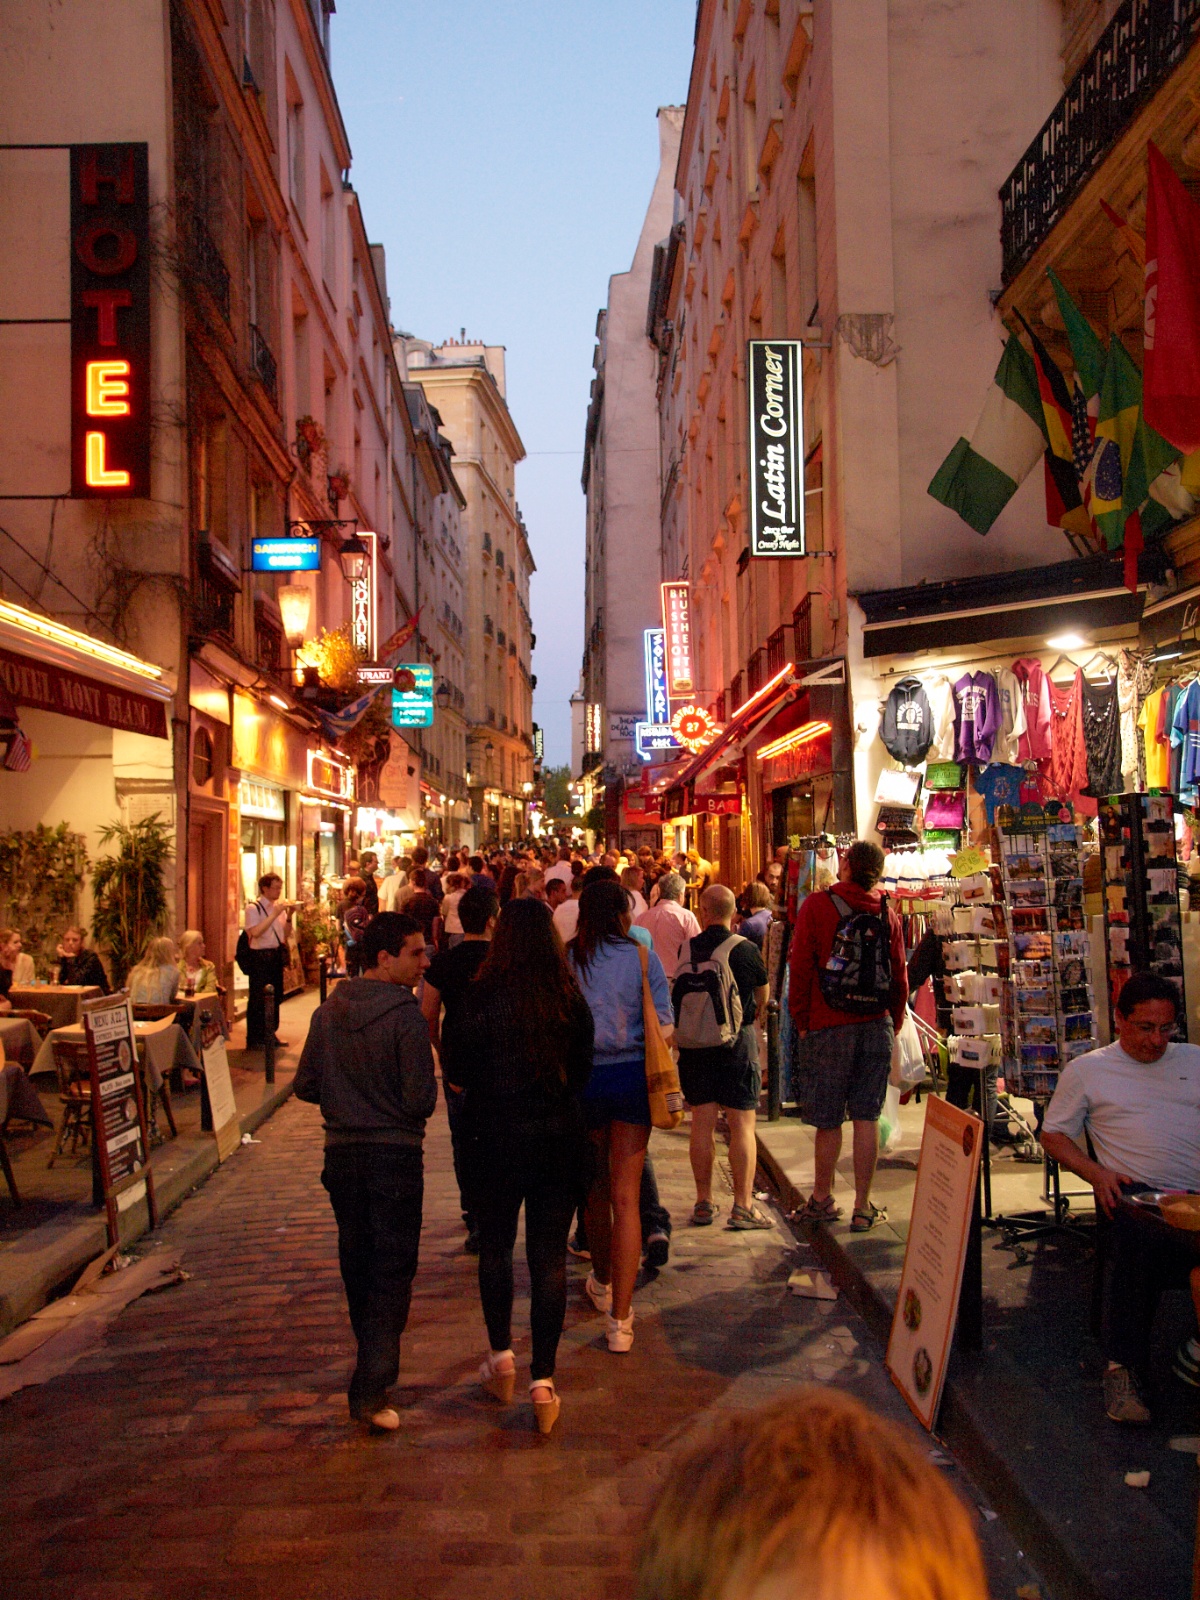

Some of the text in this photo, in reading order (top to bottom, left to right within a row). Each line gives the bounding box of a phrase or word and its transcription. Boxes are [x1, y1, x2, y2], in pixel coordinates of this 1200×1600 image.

[75, 147, 137, 487] HOTEL
[761, 345, 788, 523] Latin Corner
[679, 589, 691, 678] HUCHETTE
[58, 678, 100, 717] MONT
[671, 705, 695, 728] BISTRO
[686, 722, 700, 733] 27
